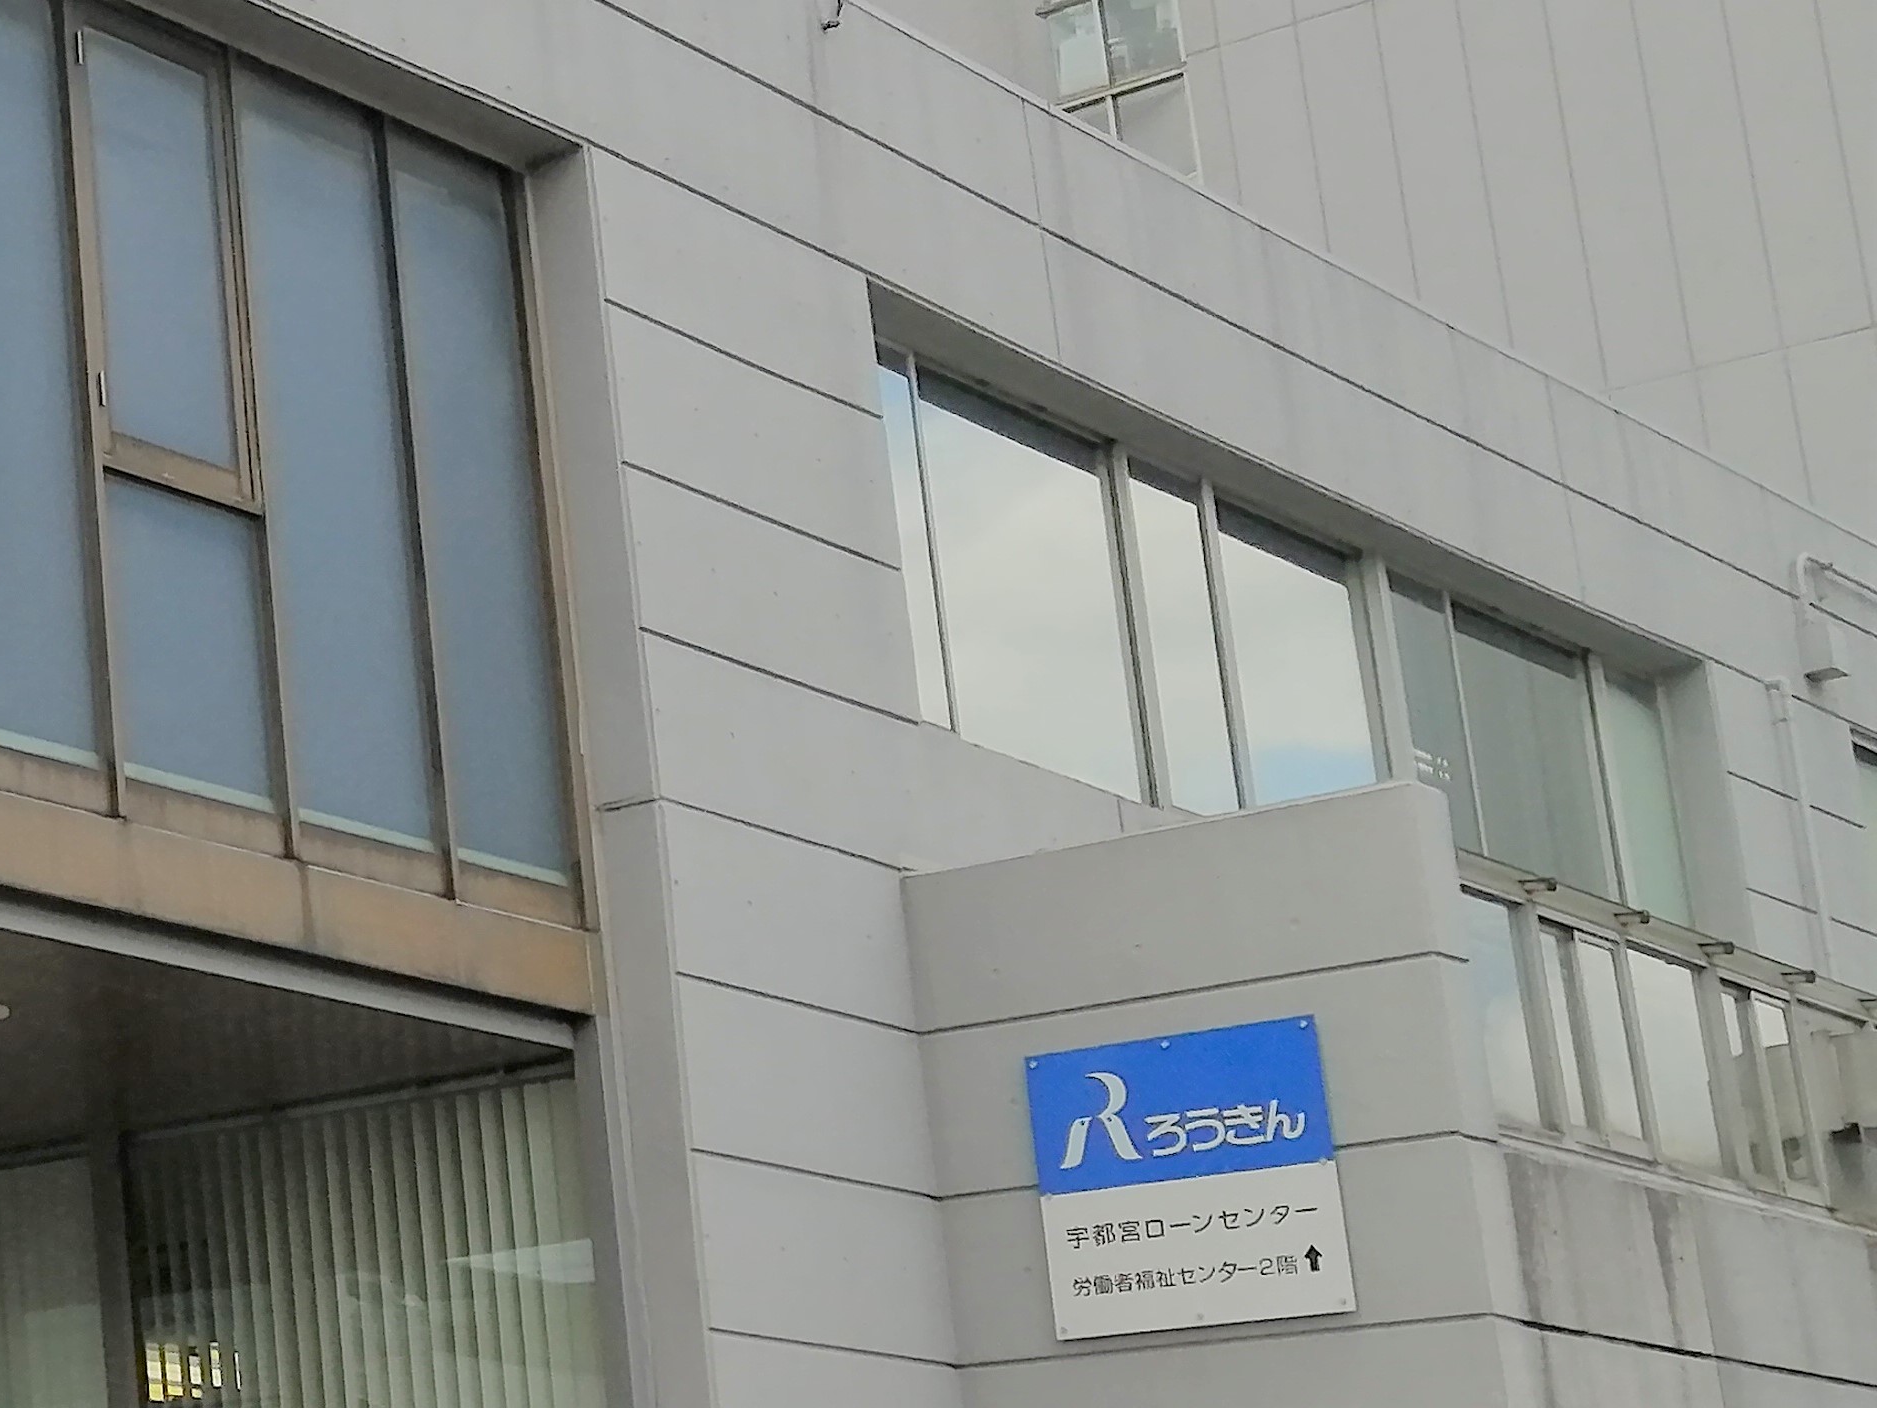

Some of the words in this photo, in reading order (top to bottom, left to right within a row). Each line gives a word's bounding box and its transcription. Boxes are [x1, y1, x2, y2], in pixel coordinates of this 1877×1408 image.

[1144, 1098, 1306, 1158] ろうきん
[1065, 1204, 1319, 1250] 宇都宮ローンセンター
